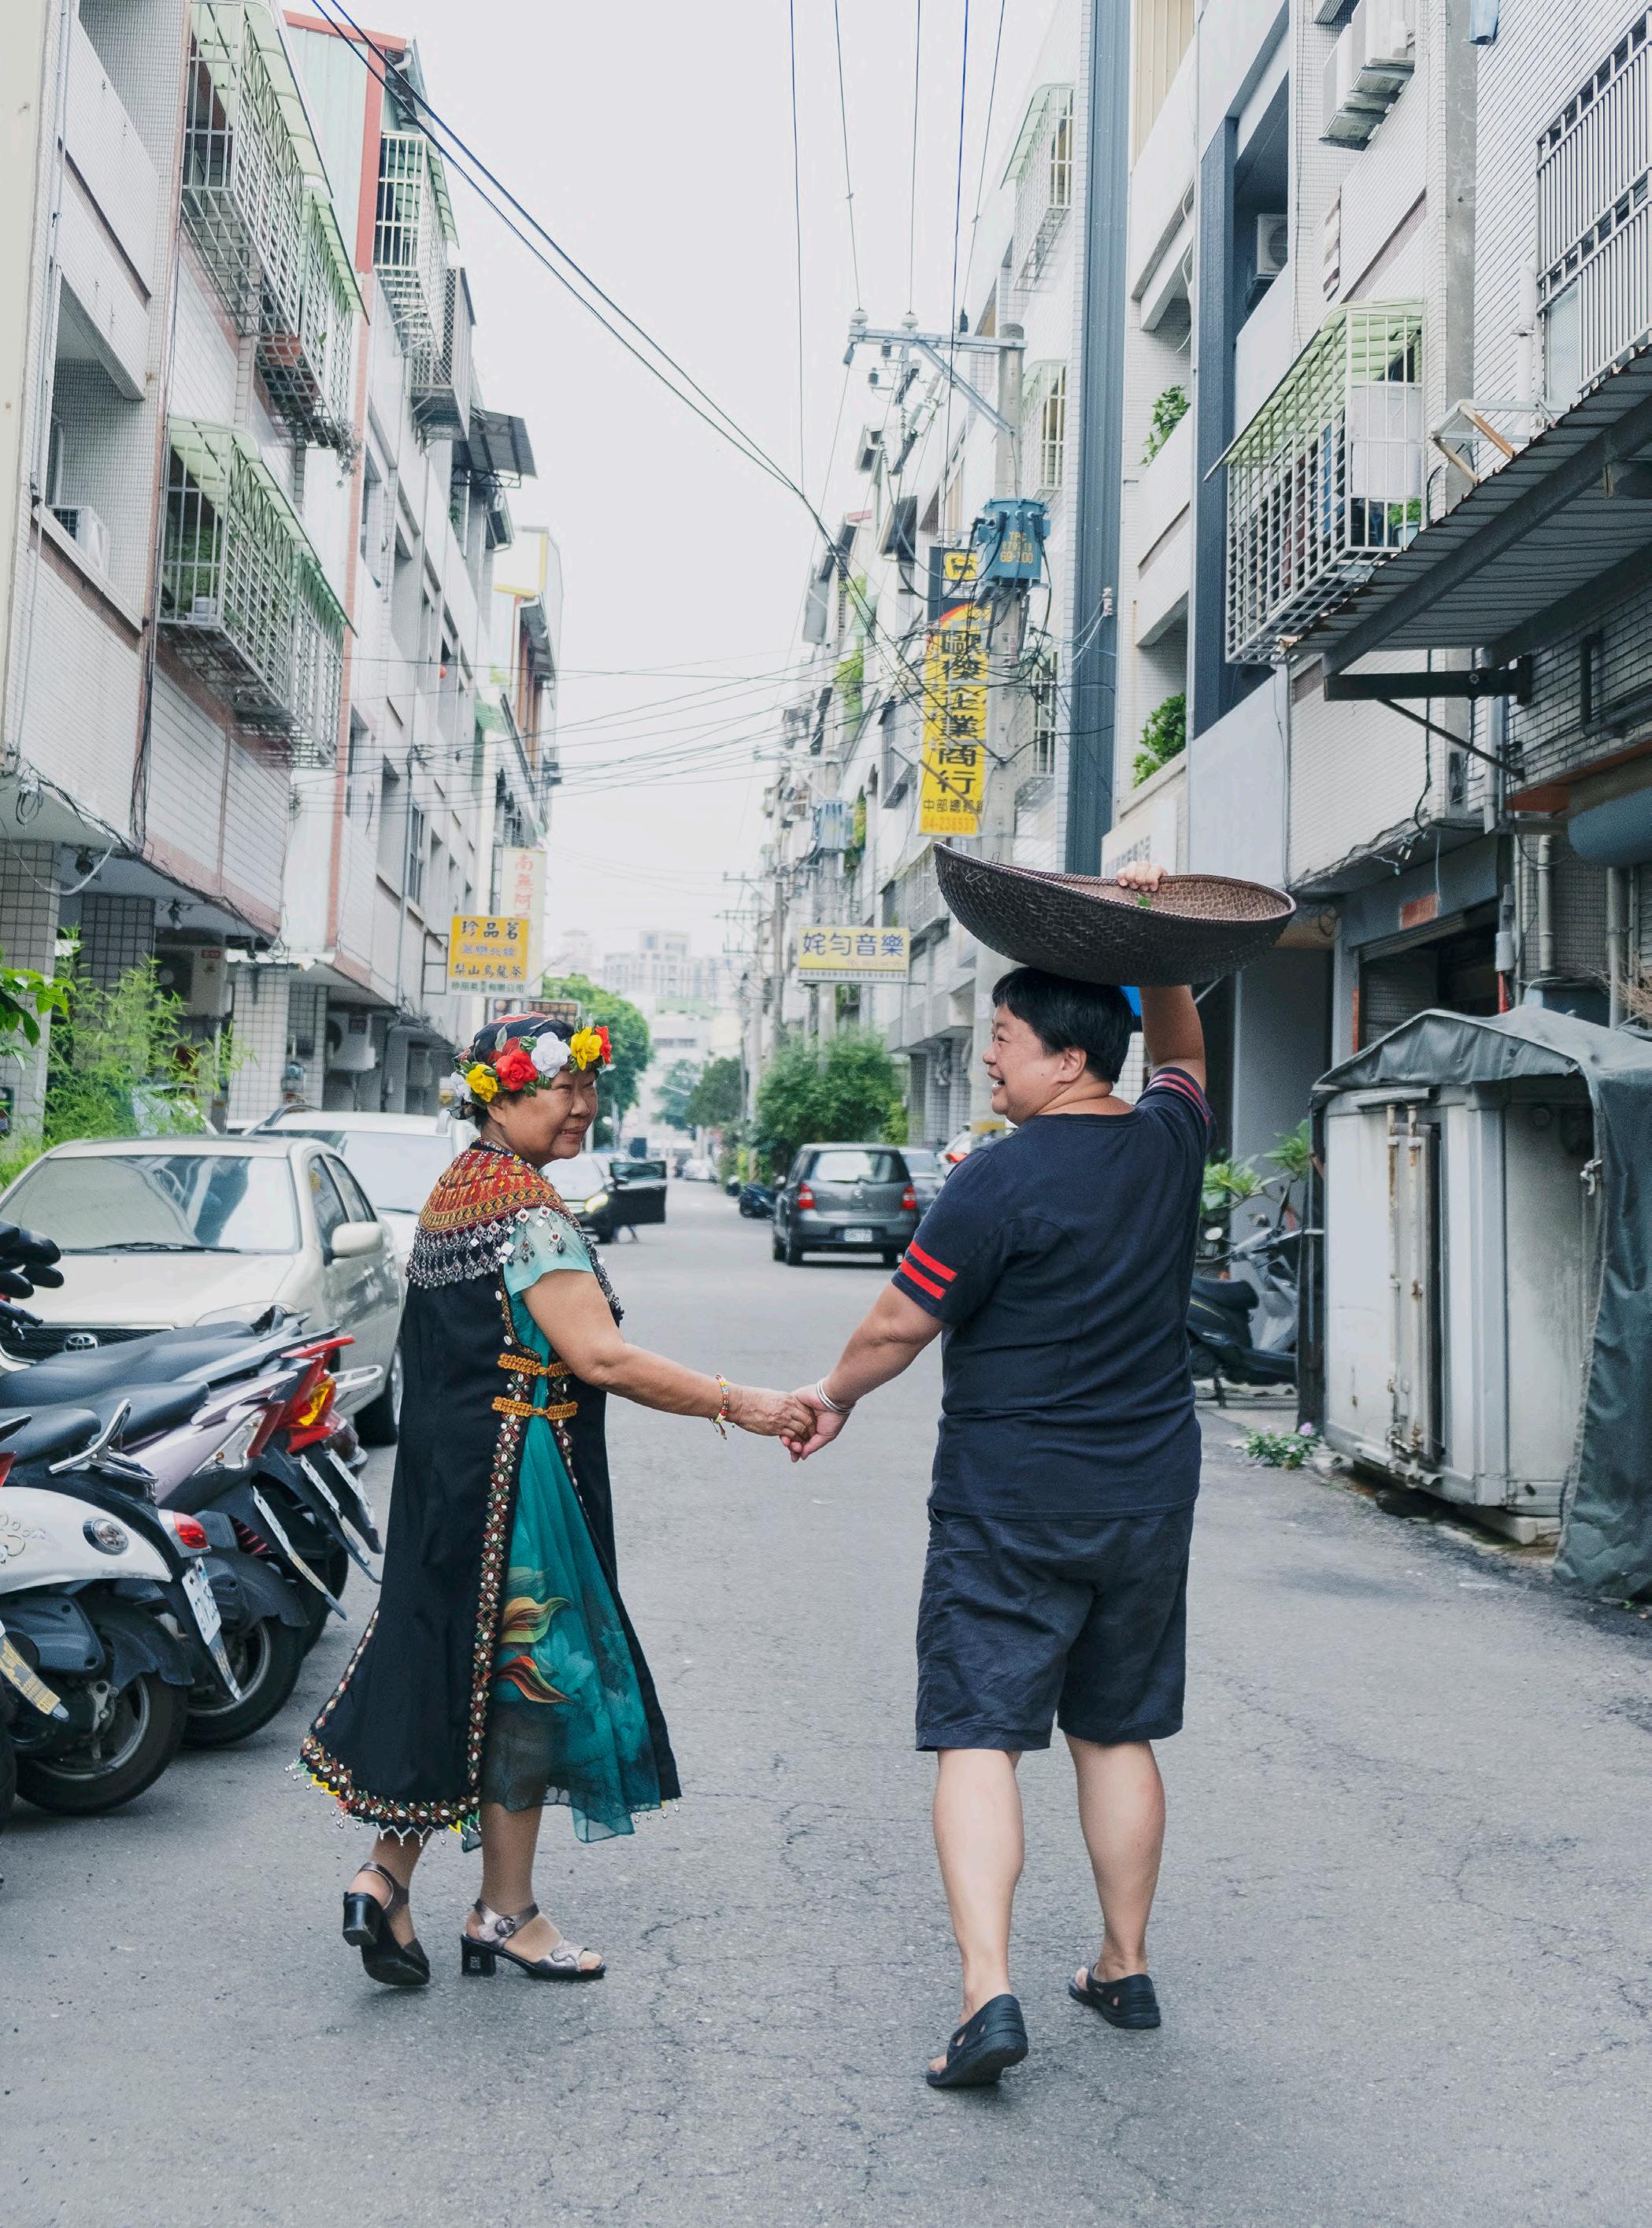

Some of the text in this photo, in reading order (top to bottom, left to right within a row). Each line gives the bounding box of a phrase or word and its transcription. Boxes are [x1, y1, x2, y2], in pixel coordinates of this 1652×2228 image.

[514, 854, 534, 918] 南無阿
[461, 920, 519, 940] 珍品茗
